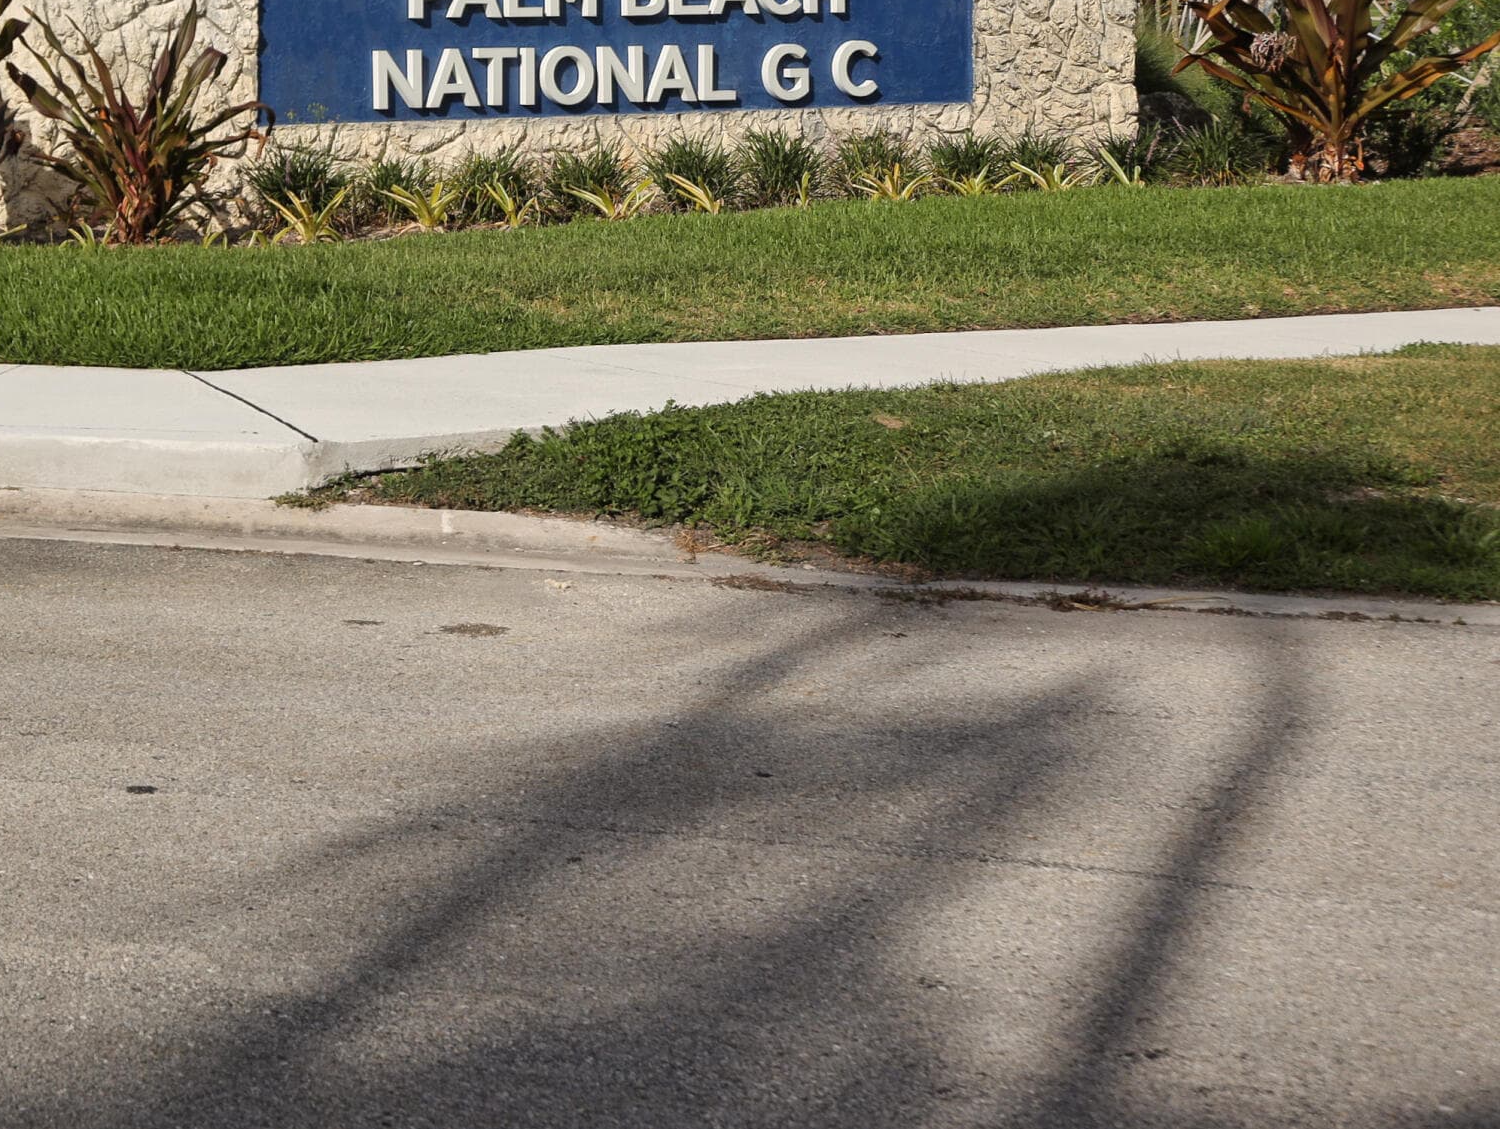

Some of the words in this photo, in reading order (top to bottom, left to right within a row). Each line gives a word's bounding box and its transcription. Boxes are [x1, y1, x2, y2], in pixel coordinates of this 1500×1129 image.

[371, 45, 737, 111] NATIONAL
[761, 43, 810, 102] G
[831, 39, 879, 98] C
